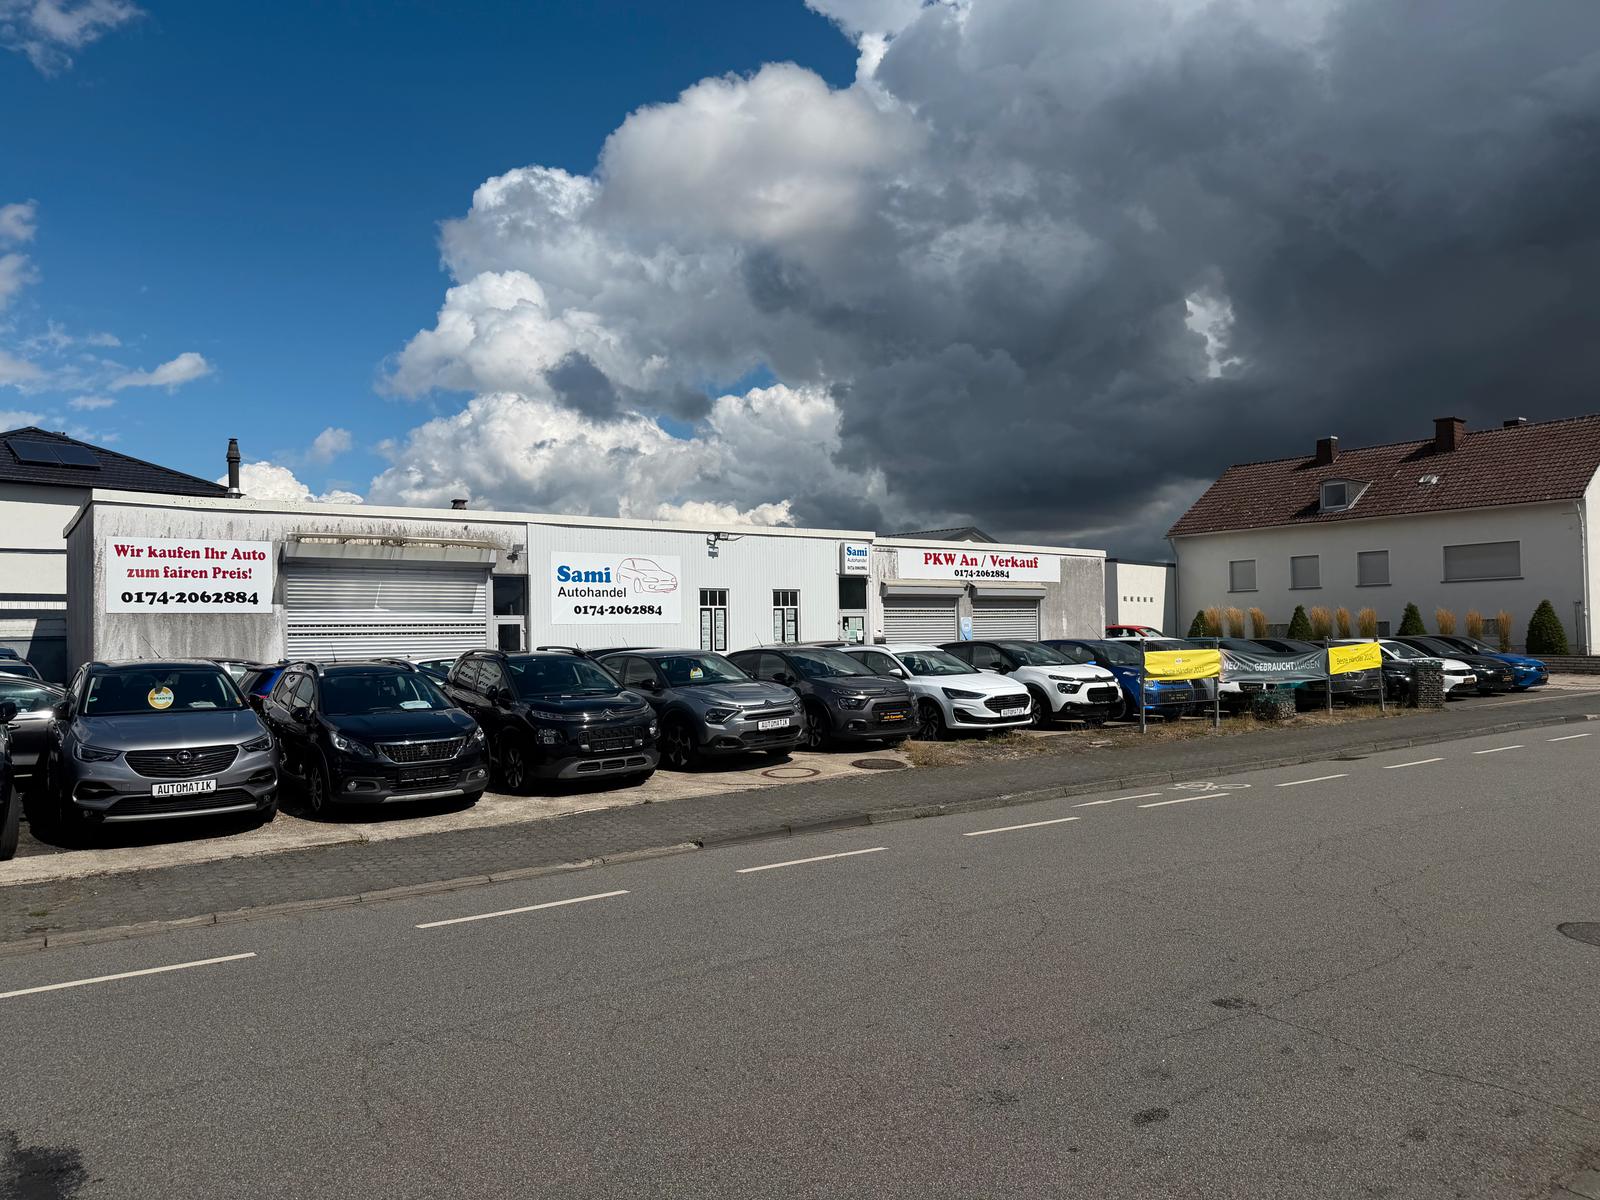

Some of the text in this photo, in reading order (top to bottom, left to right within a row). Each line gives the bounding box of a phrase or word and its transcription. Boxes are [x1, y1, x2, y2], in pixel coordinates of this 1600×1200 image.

[113, 544, 267, 561] Wir kaufen Ihr Auto
[847, 546, 868, 557] Sami
[923, 552, 957, 566] PKW
[959, 555, 978, 567] An
[989, 555, 1039, 569] Verkauf
[126, 566, 253, 580] zum fairen Preis!
[556, 565, 612, 583] Sami
[954, 569, 1010, 578] 0174-2062884
[120, 591, 259, 605] 0174-2062884
[557, 586, 627, 598] Autohandel
[573, 604, 663, 616] 0174-2062884
[157, 780, 212, 795] AUTOMATIK
